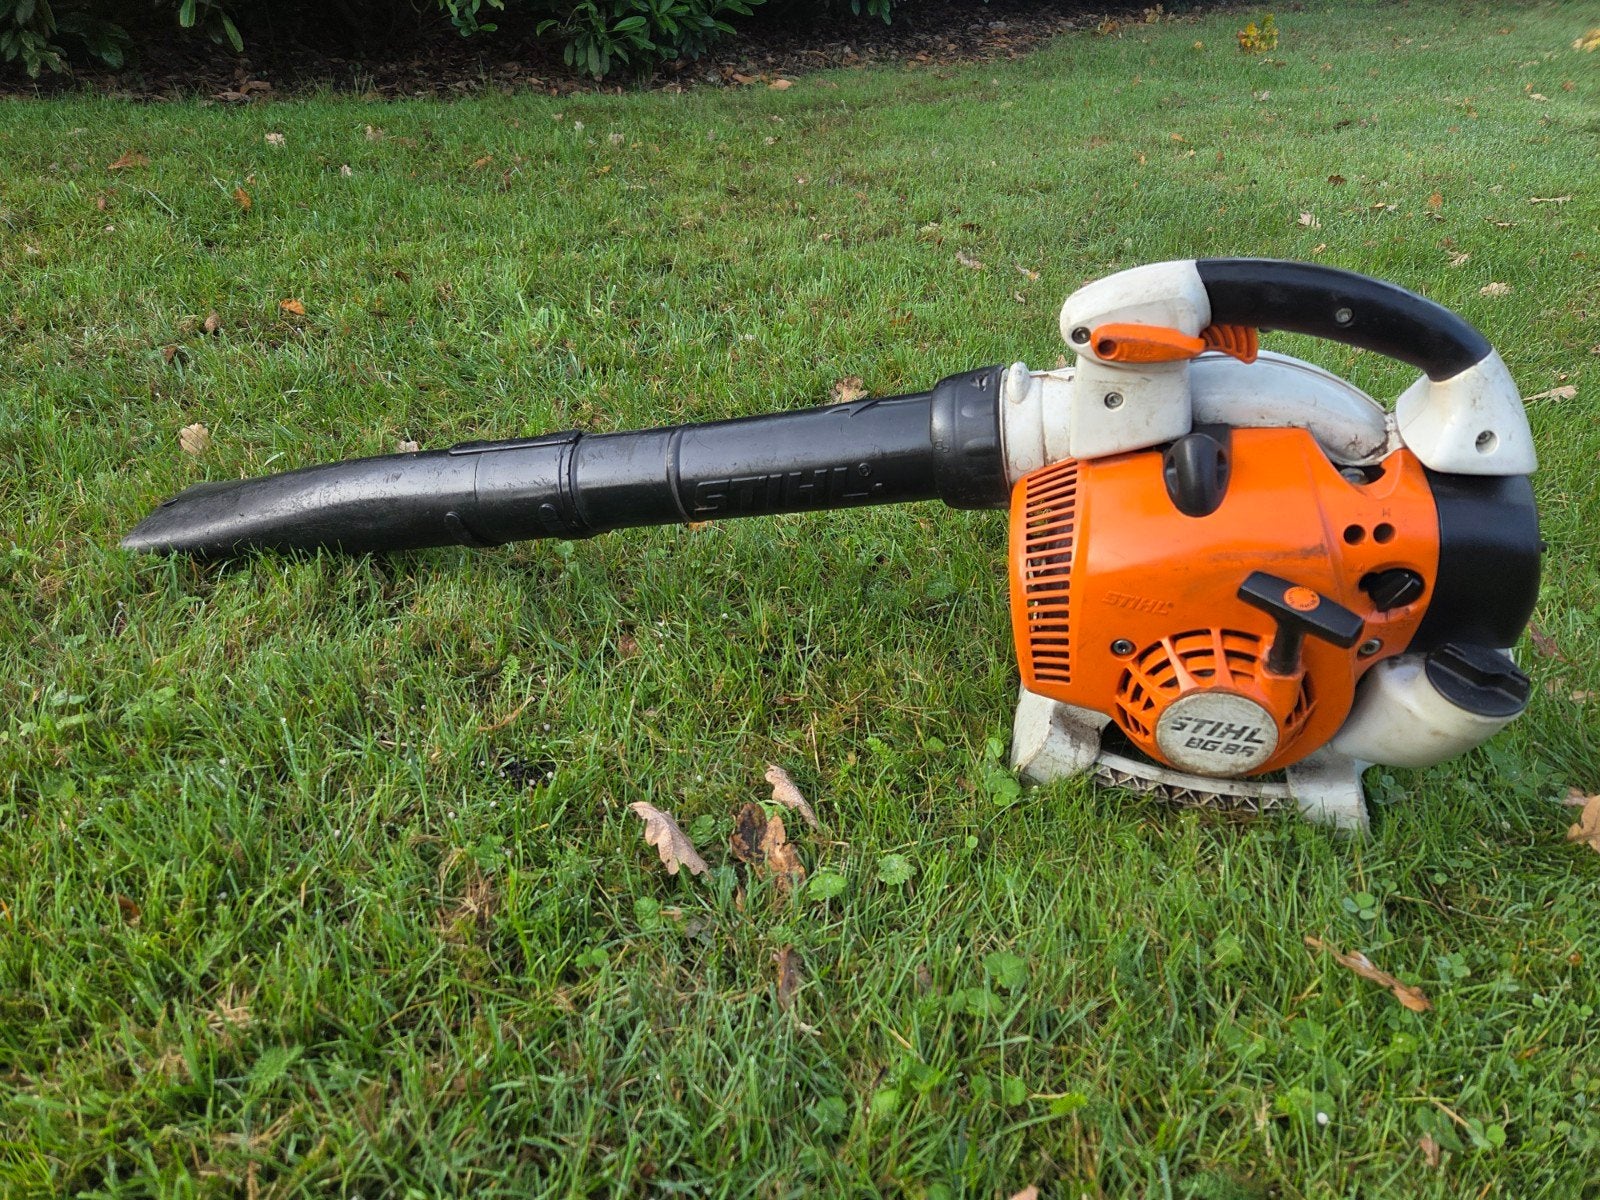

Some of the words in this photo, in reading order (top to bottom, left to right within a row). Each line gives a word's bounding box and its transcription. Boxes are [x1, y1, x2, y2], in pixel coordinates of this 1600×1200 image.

[693, 465, 870, 514] STIHL
[1101, 590, 1169, 616] STIHL
[1170, 716, 1265, 744] STIHL
